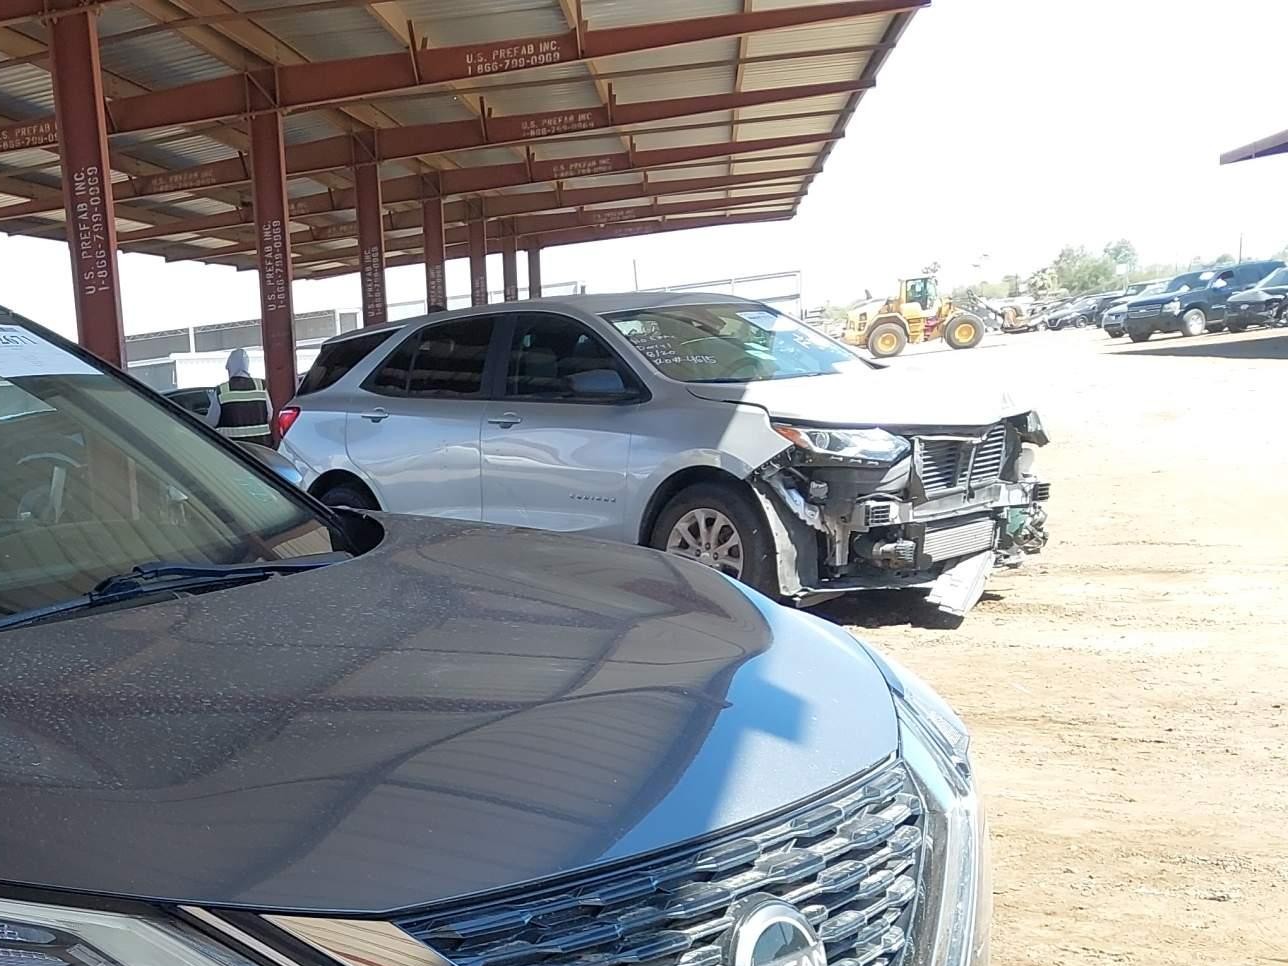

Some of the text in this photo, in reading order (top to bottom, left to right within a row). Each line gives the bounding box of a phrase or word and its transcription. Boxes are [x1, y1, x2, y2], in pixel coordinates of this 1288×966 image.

[466, 40, 561, 64] U.S. PREFAB INC.
[73, 167, 97, 295] U.S. PREFAB INC.
[264, 245, 275, 287] PREFAB
